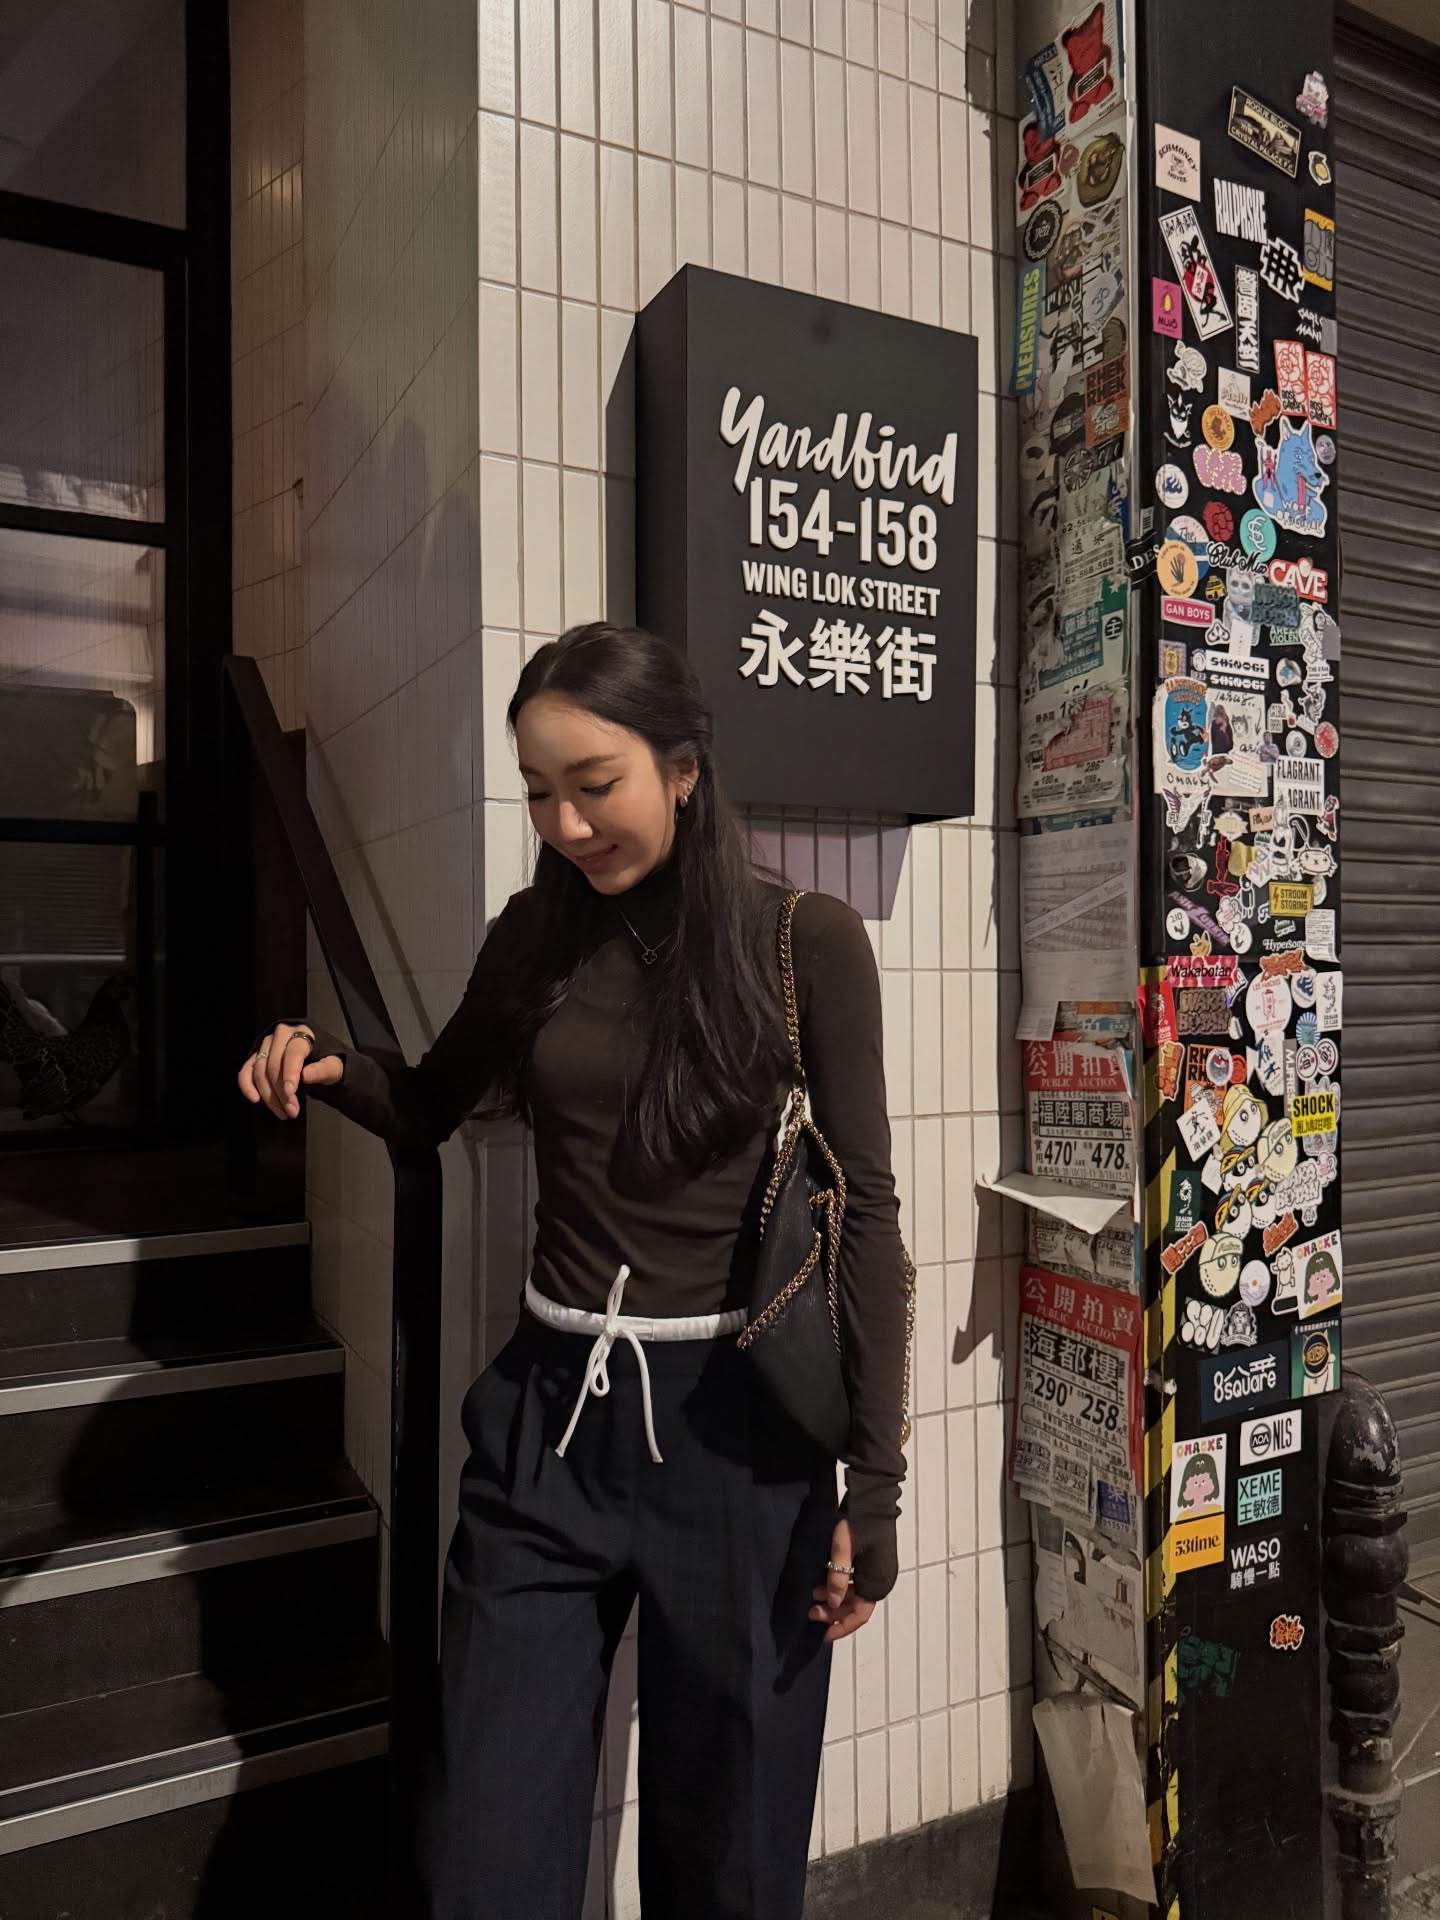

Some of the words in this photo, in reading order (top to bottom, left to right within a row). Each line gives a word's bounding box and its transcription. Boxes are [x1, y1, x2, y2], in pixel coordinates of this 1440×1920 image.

[1159, 144, 1197, 171] SCHMONEY
[1016, 268, 1040, 392] PLEASURES
[720, 386, 957, 505] Yardbird
[749, 477, 937, 570] 154-158
[742, 560, 807, 599] WING
[813, 571, 857, 607] LOK
[860, 577, 940, 617] STREET
[1270, 561, 1326, 599] CAVE
[1166, 604, 1184, 616] GAN
[1187, 606, 1210, 620] BOYS
[739, 609, 937, 702] 永樂街
[1278, 760, 1320, 782] FLAGRANT
[1280, 888, 1307, 899] STROOM
[1280, 898, 1308, 911] STORING
[1171, 964, 1232, 979] Wakabotan
[1041, 1077, 1071, 1088] PUBLIC
[1078, 1077, 1117, 1088] AUCTION
[1294, 1094, 1334, 1118] SHOCK
[1092, 1143, 1125, 1170] 478
[1024, 1278, 1136, 1336] 公開拍賣
[1037, 1303, 1071, 1323] PUBLIC
[1076, 1320, 1117, 1341] AUCTION
[1030, 1326, 1117, 1388] 海都樓
[1080, 1393, 1119, 1431] 258
[1273, 1417, 1293, 1451] NLS
[1240, 1471, 1281, 1500] XEME
[1240, 1496, 1281, 1523] 王敏德
[1231, 1537, 1281, 1569] WASO
[1230, 1563, 1281, 1590] 騎慢一點
